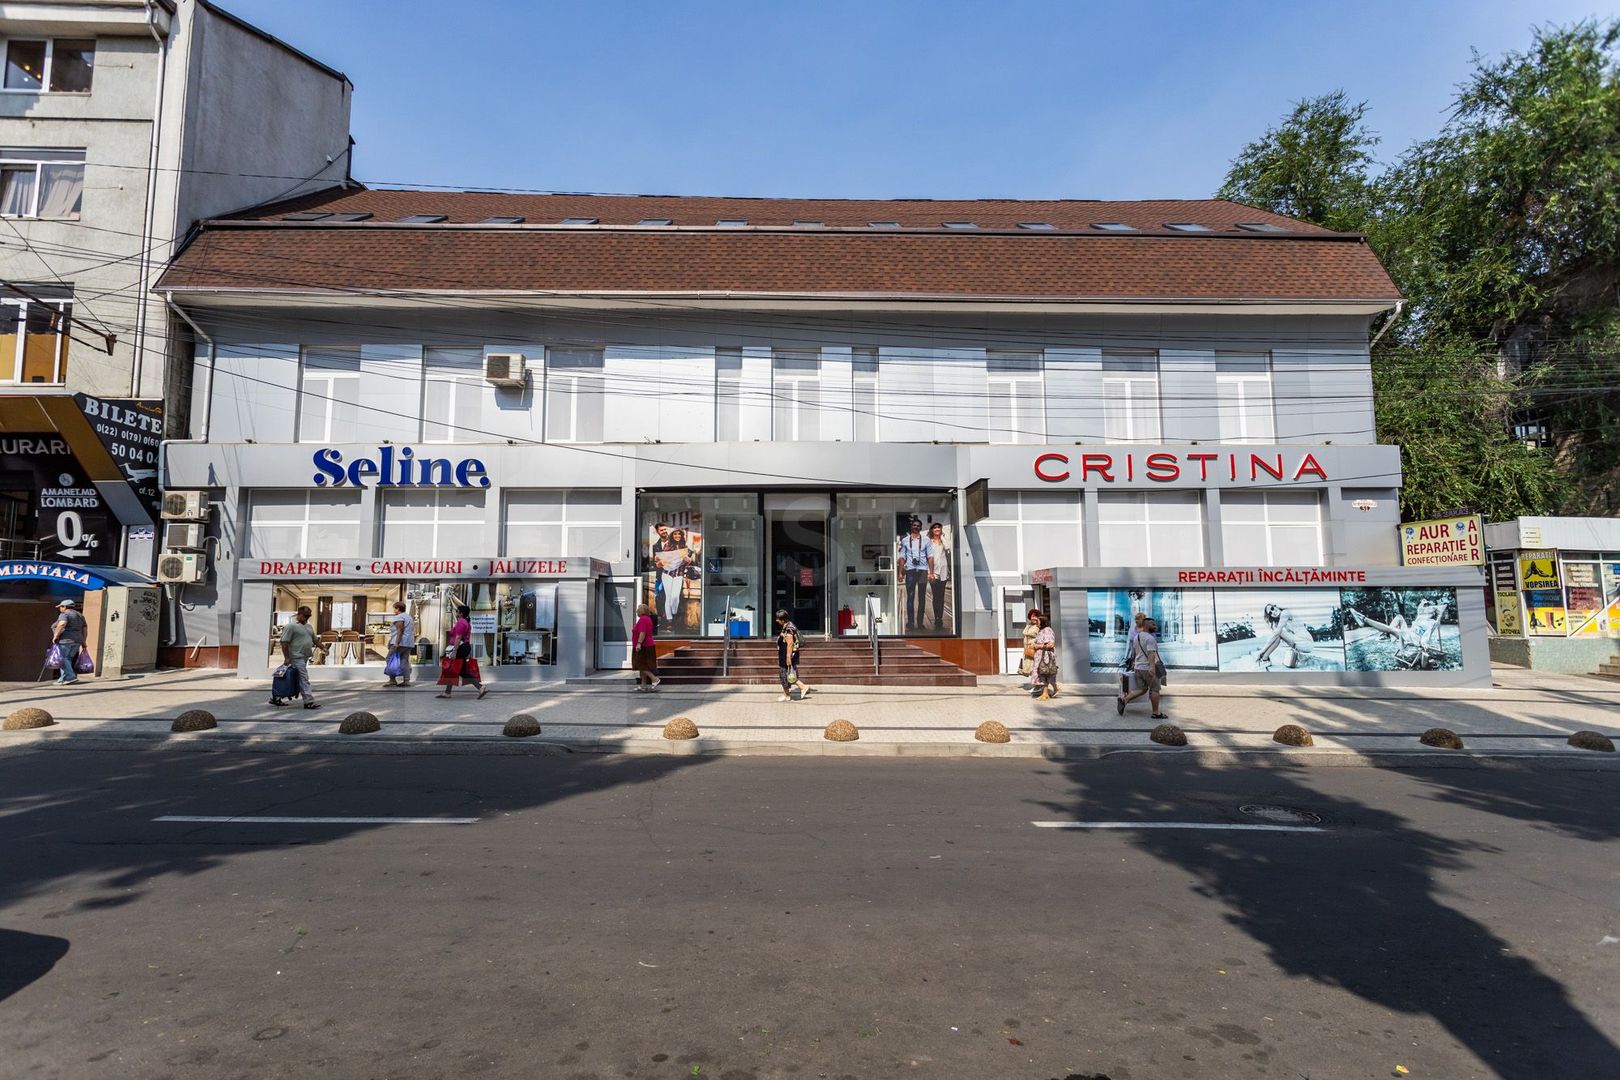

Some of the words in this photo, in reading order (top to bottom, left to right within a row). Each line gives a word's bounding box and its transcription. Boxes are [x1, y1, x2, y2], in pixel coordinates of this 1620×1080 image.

[84, 397, 162, 434] BILETE
[96, 423, 118, 437] 0(22)
[111, 443, 126, 457] 50
[129, 447, 144, 461] 04
[313, 446, 491, 489] Seline
[1034, 453, 1328, 481] CRISTINA
[41, 488, 97, 496] AMANET.MD
[41, 498, 99, 508] LOMBARD
[1419, 524, 1450, 541] AUR
[260, 561, 342, 575] DRAPERII
[370, 561, 463, 575] CARNIZURI
[488, 560, 567, 576] JALUZELE
[1525, 579, 1560, 590] VOPSIREA
